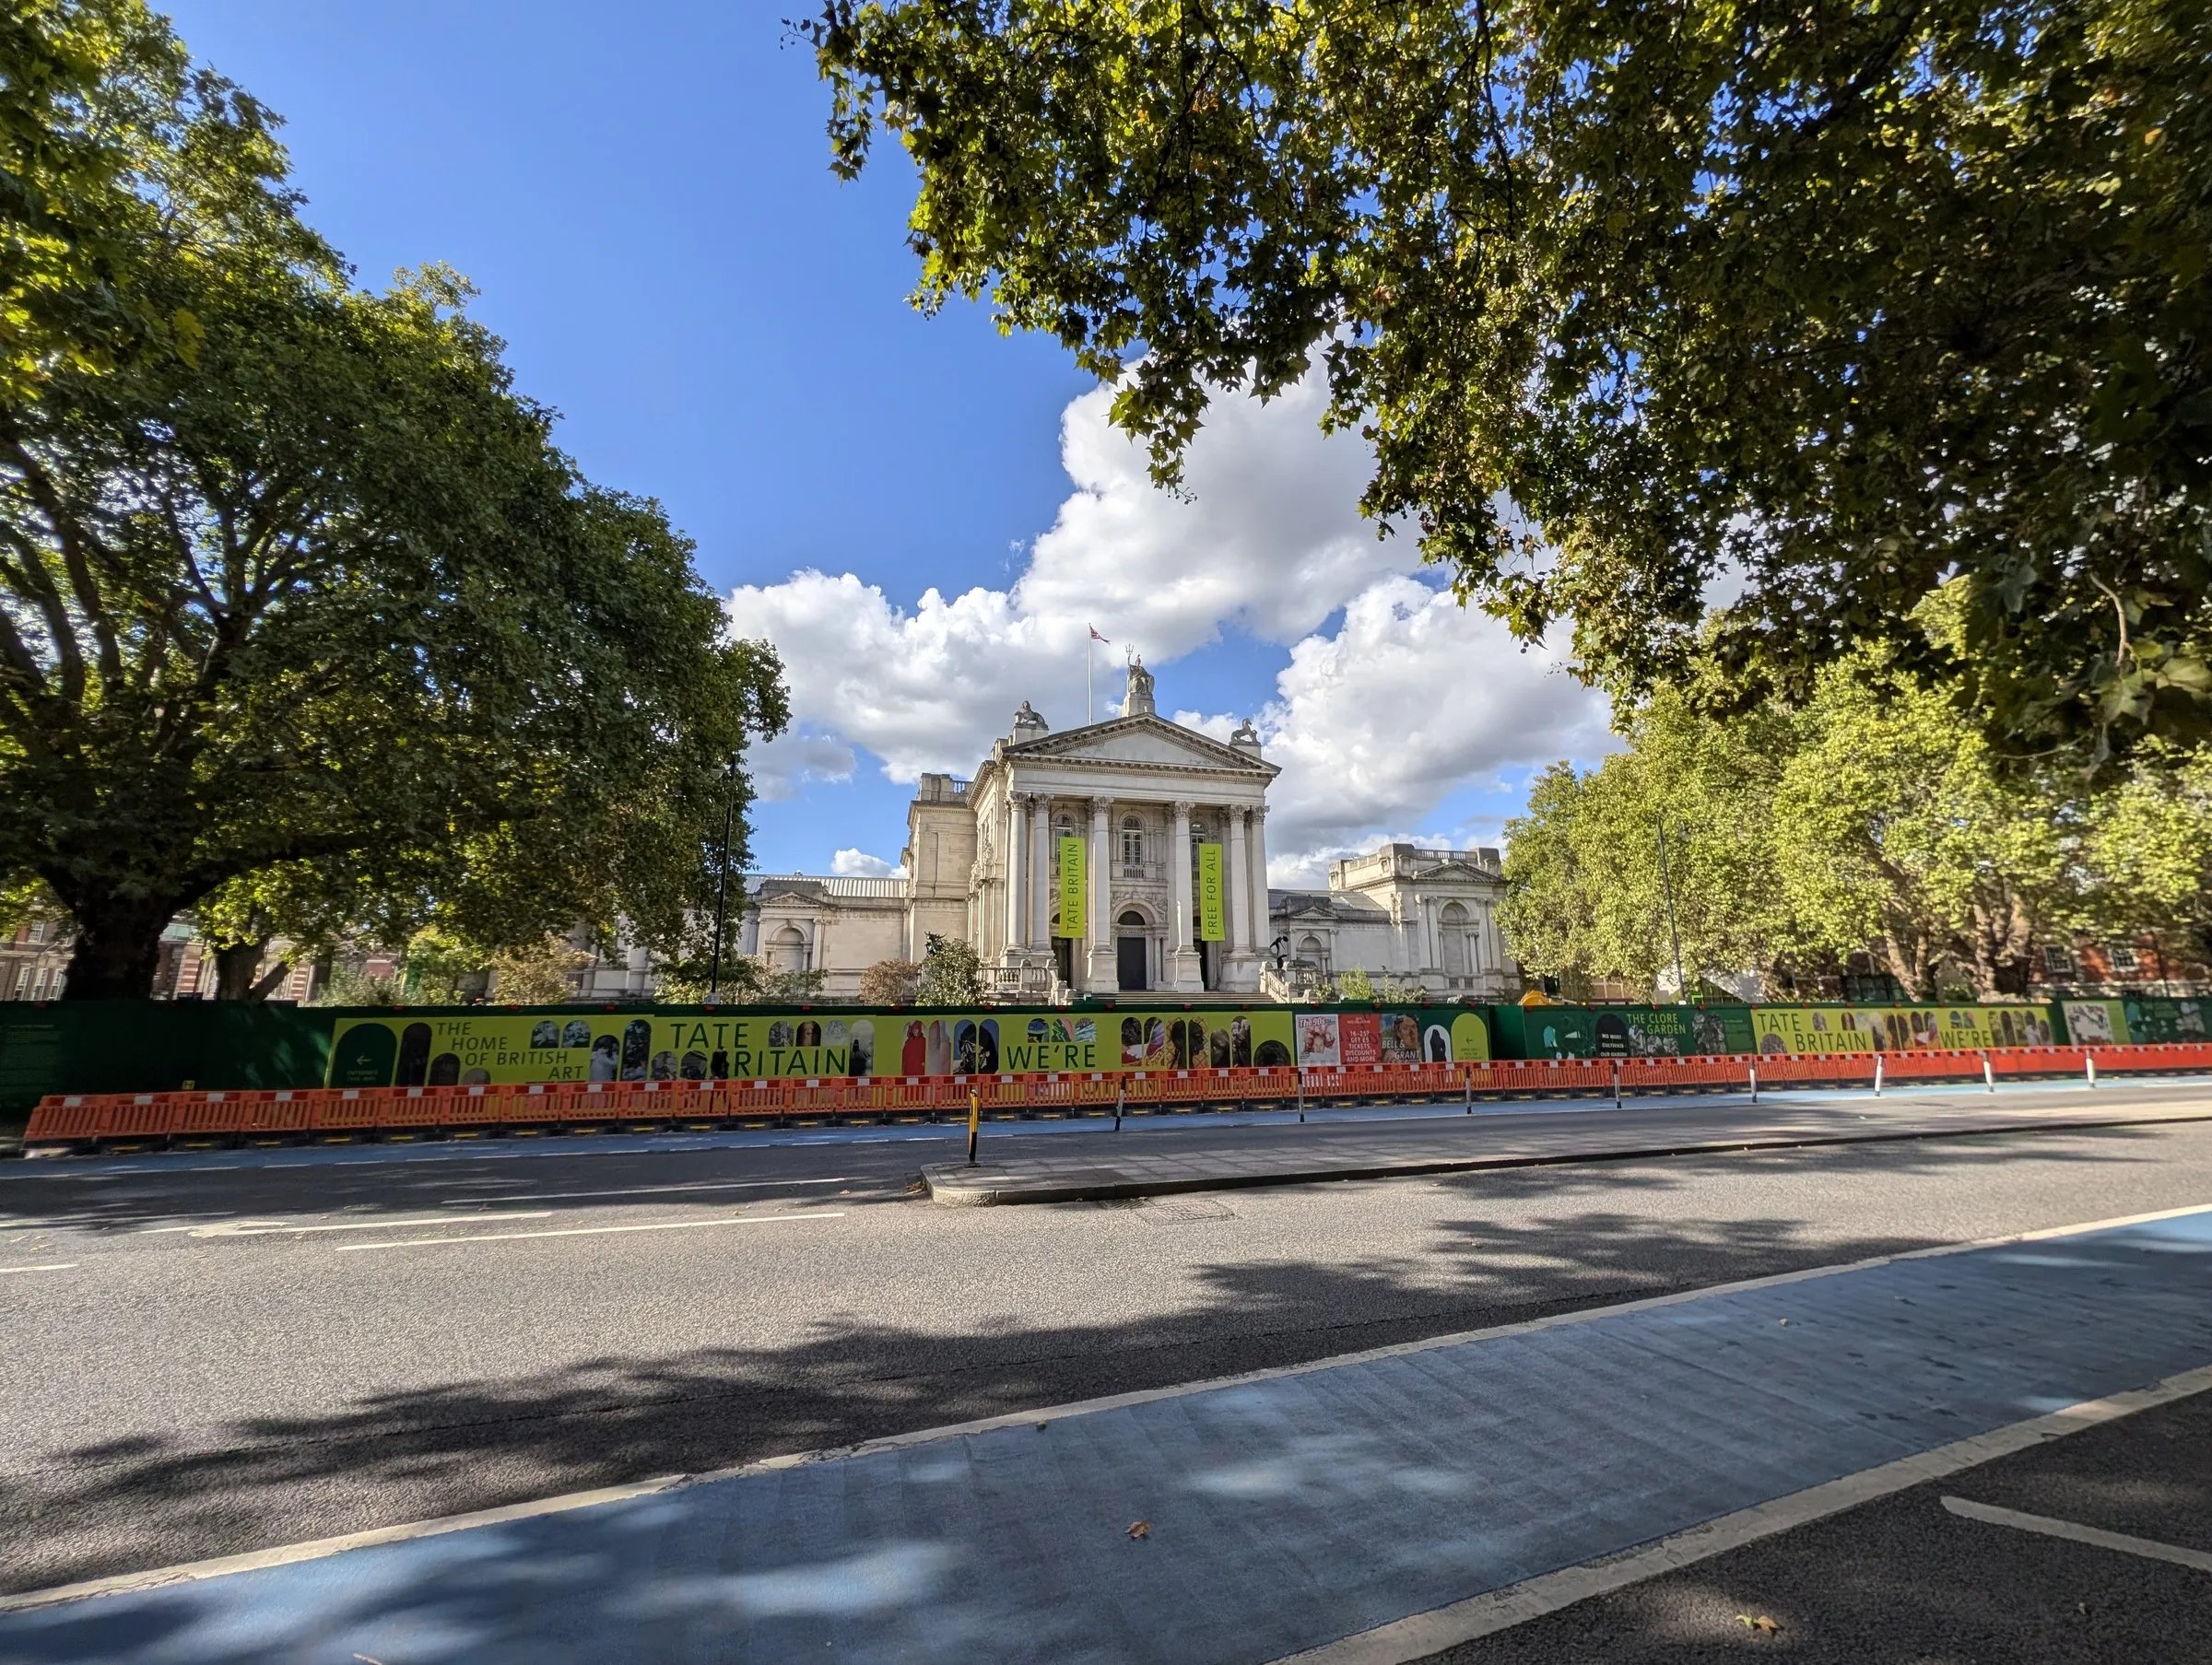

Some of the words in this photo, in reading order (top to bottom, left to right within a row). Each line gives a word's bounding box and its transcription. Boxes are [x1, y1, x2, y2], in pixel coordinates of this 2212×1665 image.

[1067, 844, 1078, 896] BRITAIN
[1206, 849, 1216, 872] ALL
[1206, 876, 1217, 900] FOR
[1066, 901, 1078, 932] TATE
[1207, 906, 1218, 935] FREE
[1299, 1018, 1312, 1027] The
[1312, 1017, 1325, 1026] 90s
[1627, 1014, 1645, 1024] THE
[1649, 1014, 1678, 1024] CLORE
[1758, 1014, 1801, 1032] TATE
[437, 1022, 472, 1036] THE
[670, 1022, 749, 1049] TATE
[1646, 1024, 1687, 1035] GARDEN
[452, 1037, 508, 1051] HOME
[1382, 1039, 1398, 1049] BELL
[1399, 1039, 1406, 1049] &
[1794, 1032, 1867, 1052] BRITAIN
[1940, 1029, 1992, 1049] WE'RE
[465, 1052, 487, 1066] OF
[497, 1050, 568, 1066] BRITISH
[726, 1049, 846, 1077] RITAIN
[1006, 1044, 1096, 1070] WE'RE
[1394, 1050, 1419, 1060] GRANT
[548, 1065, 584, 1081] ART
